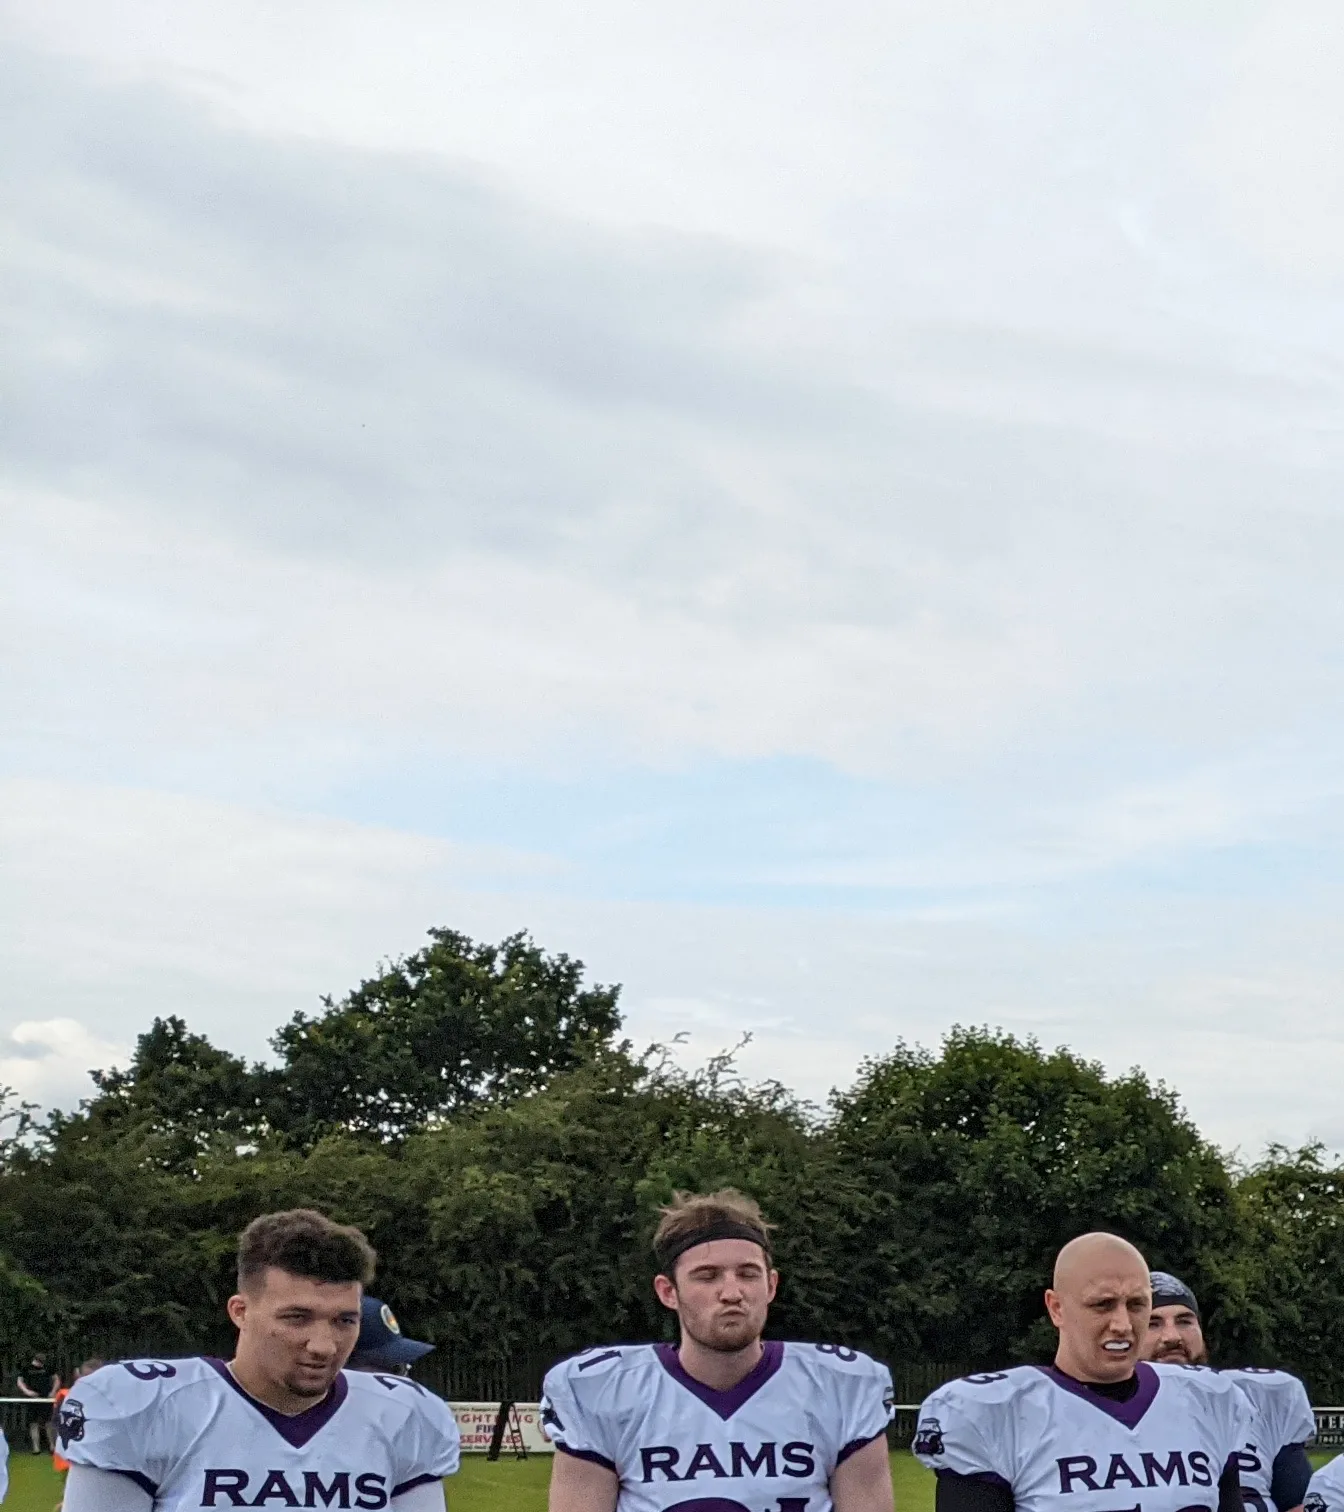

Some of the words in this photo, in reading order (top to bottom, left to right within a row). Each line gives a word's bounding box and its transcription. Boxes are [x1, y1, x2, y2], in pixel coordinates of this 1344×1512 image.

[640, 1440, 815, 1484] RAMS
[1056, 1451, 1211, 1494] RAMS
[200, 1469, 388, 1510] RAMS
